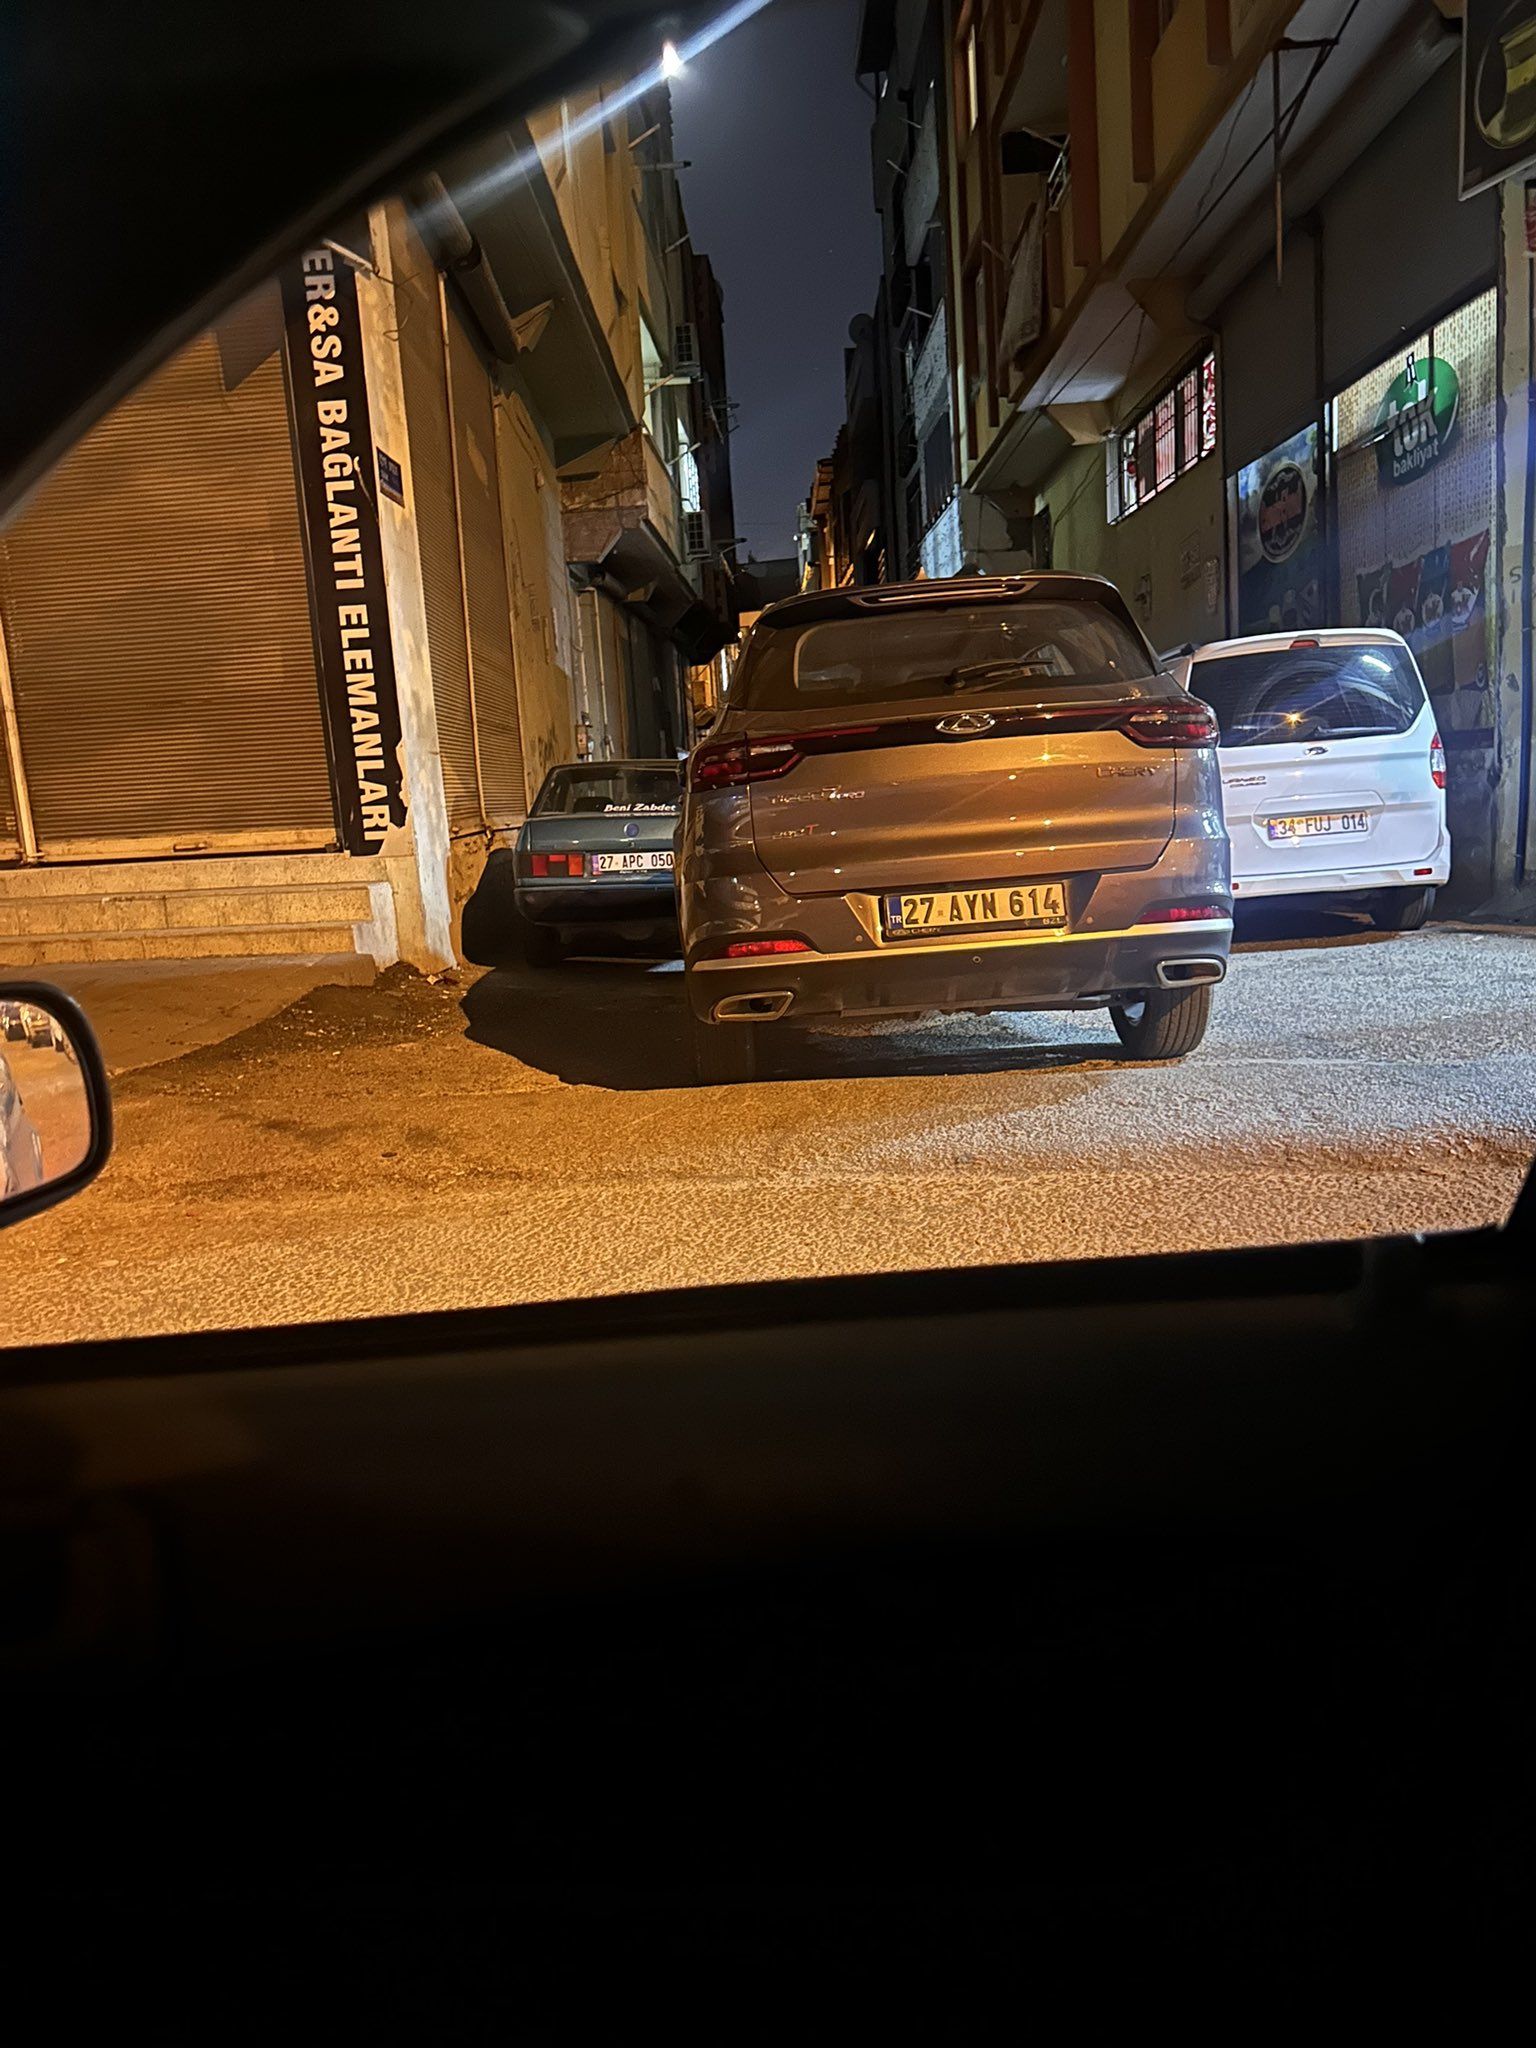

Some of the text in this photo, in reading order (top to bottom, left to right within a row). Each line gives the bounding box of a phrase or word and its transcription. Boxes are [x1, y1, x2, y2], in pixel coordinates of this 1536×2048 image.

[1393, 437, 1440, 479] bakliyat
[301, 249, 391, 841] ER&SA BAĞLANTI ELEMANLARI
[1278, 813, 1365, 835] 34 FUJ 014
[599, 853, 673, 869] 27 APC 050
[890, 915, 902, 924] TR
[903, 887, 1060, 925] 27 AYN 614
